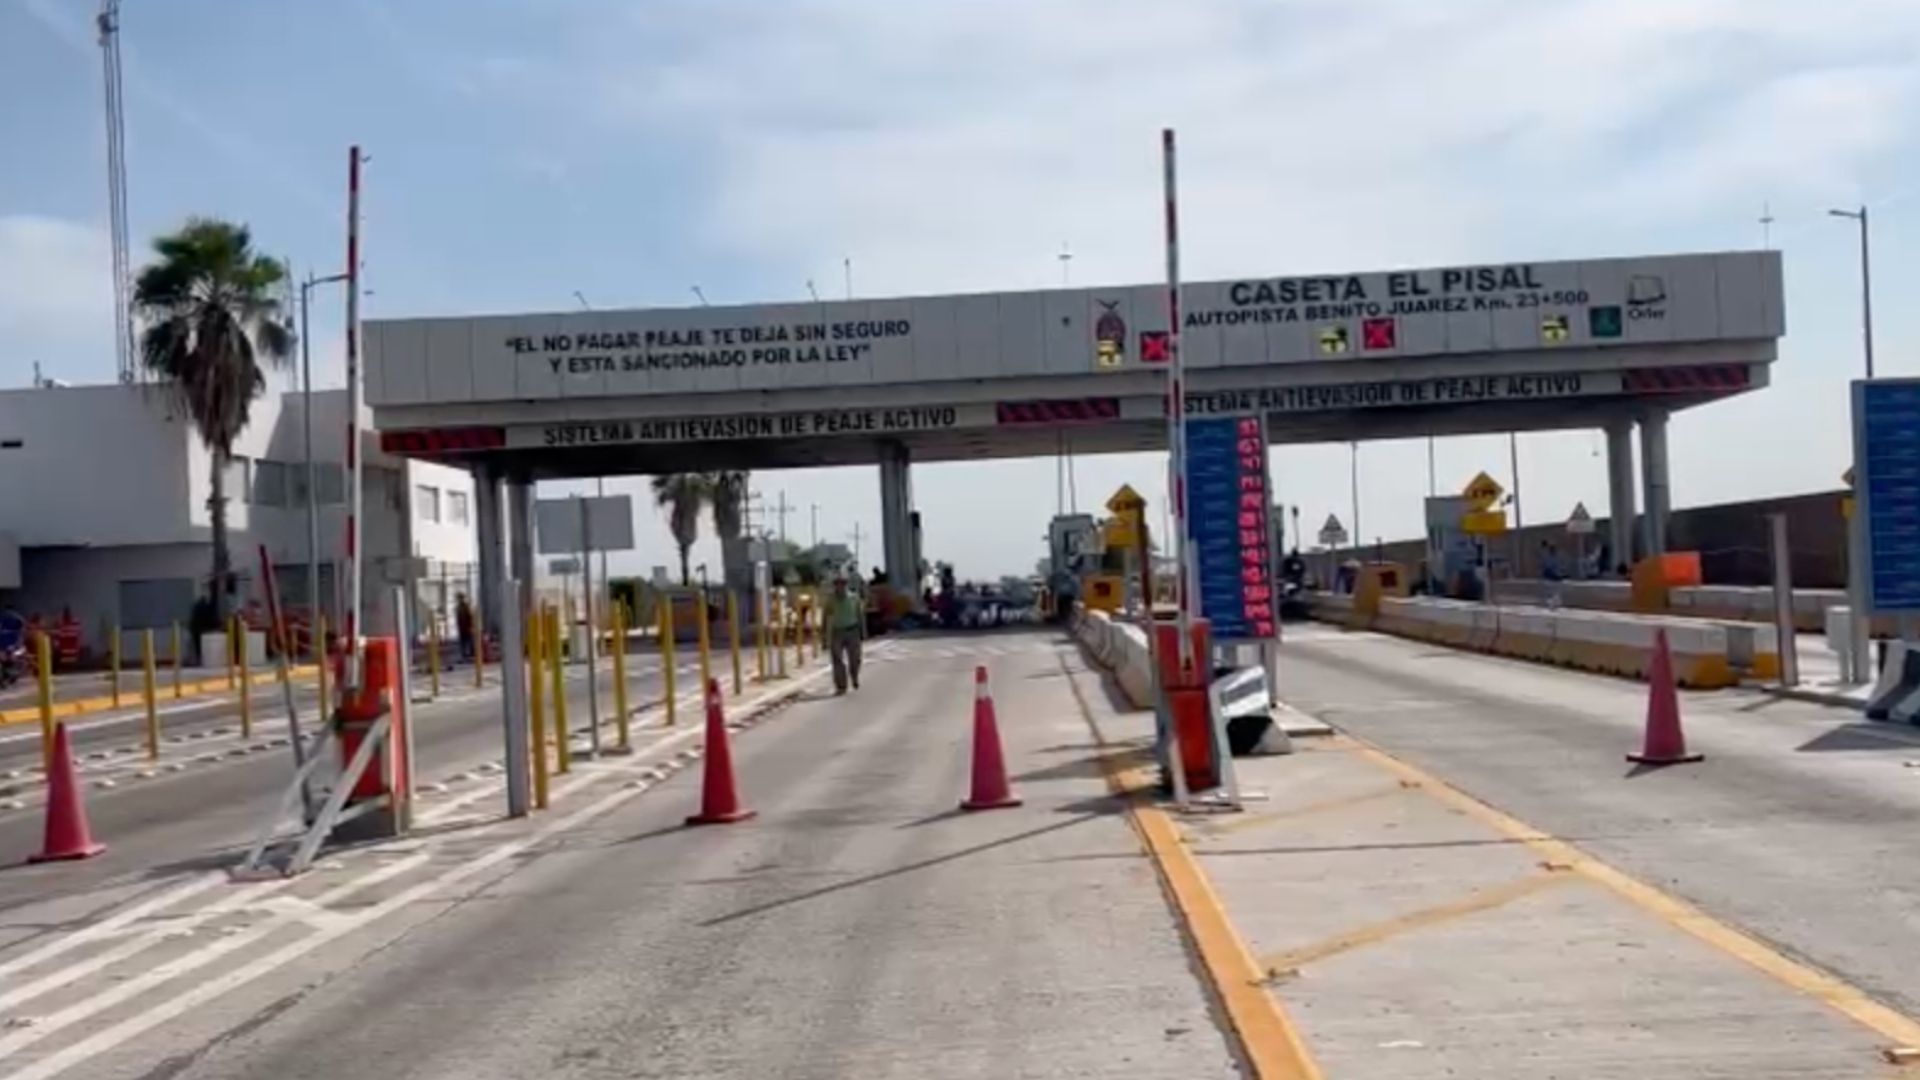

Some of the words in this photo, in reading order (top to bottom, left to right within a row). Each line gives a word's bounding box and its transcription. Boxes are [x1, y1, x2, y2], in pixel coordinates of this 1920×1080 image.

[1231, 277, 1365, 305] CASETA
[1388, 273, 1429, 297] EL
[1441, 264, 1543, 293] PISAL
[1185, 308, 1298, 326] AUTOPISTA
[1305, 302, 1380, 320] BENITO
[1388, 297, 1468, 314] JUAREZ
[1517, 289, 1590, 308] 23+500
[544, 334, 571, 351] NO
[577, 331, 641, 350] PAGAR
[645, 328, 706, 347] PEAJE
[712, 328, 735, 345] TE
[740, 324, 789, 343] DEJA
[793, 323, 826, 341] SIN
[831, 319, 911, 339] SEGURO
[548, 356, 562, 374] Y
[568, 355, 617, 373] ESTA
[622, 349, 747, 371] SANCIONADO
[752, 347, 793, 366] POR
[796, 345, 821, 362] LA
[1400, 381, 1429, 401] DE
[1433, 376, 1498, 400] PEAJE
[1505, 372, 1581, 396] ACTIVO
[543, 424, 634, 446] SISTEMA
[780, 415, 809, 435] DE
[813, 411, 876, 433] PEAJE
[882, 406, 957, 429] ACTIVO
